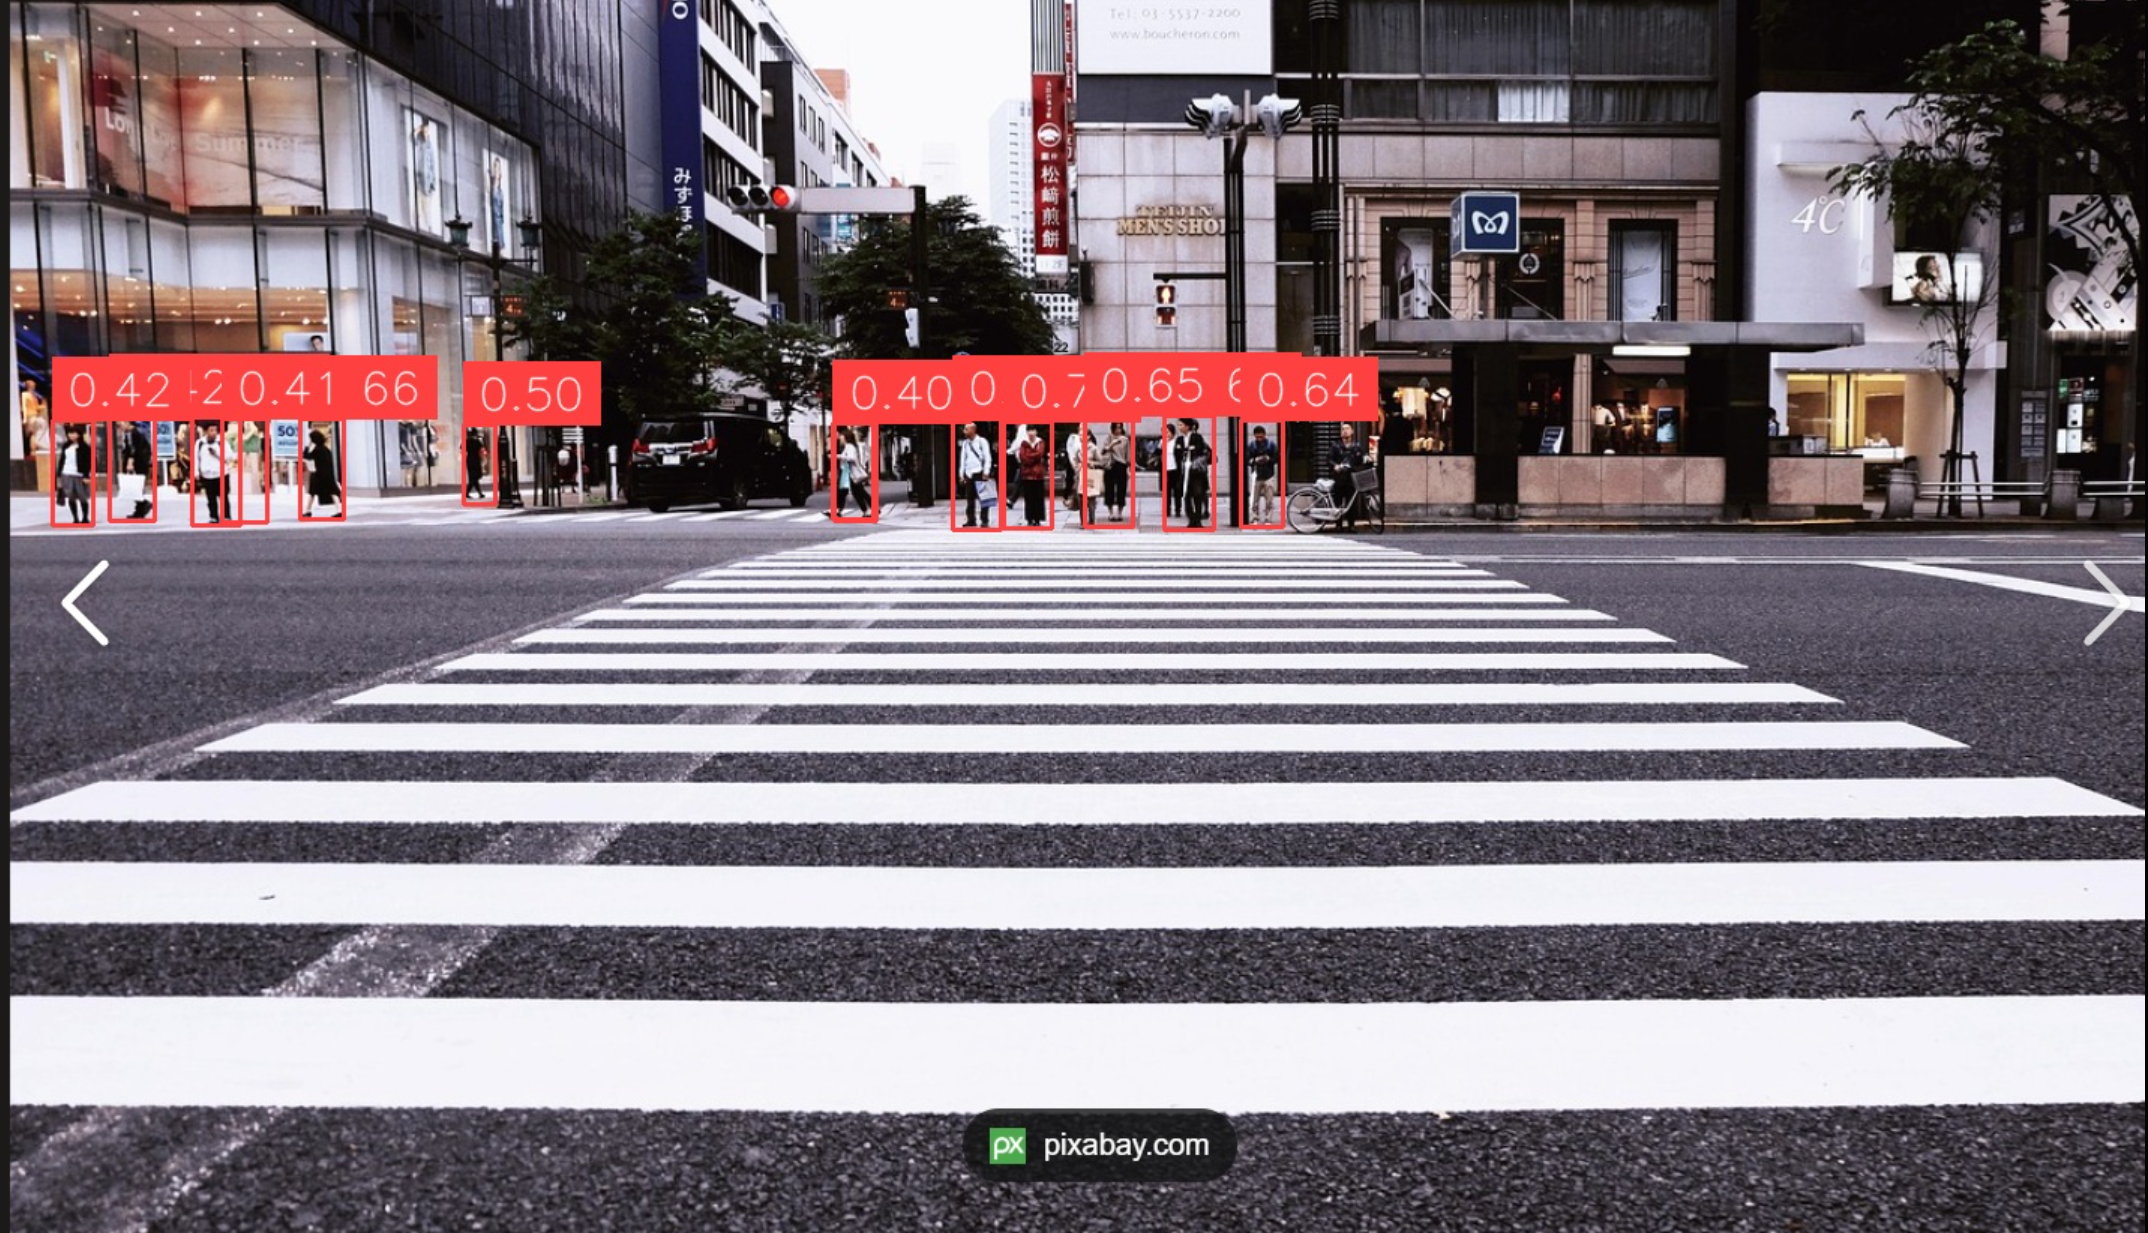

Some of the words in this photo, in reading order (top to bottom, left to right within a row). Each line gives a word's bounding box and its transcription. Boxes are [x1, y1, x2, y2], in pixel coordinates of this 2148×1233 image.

[1110, 28, 1240, 39] www.boucheron.com
[1136, 204, 1215, 217] TEIJIN
[278, 425, 298, 437] 50
